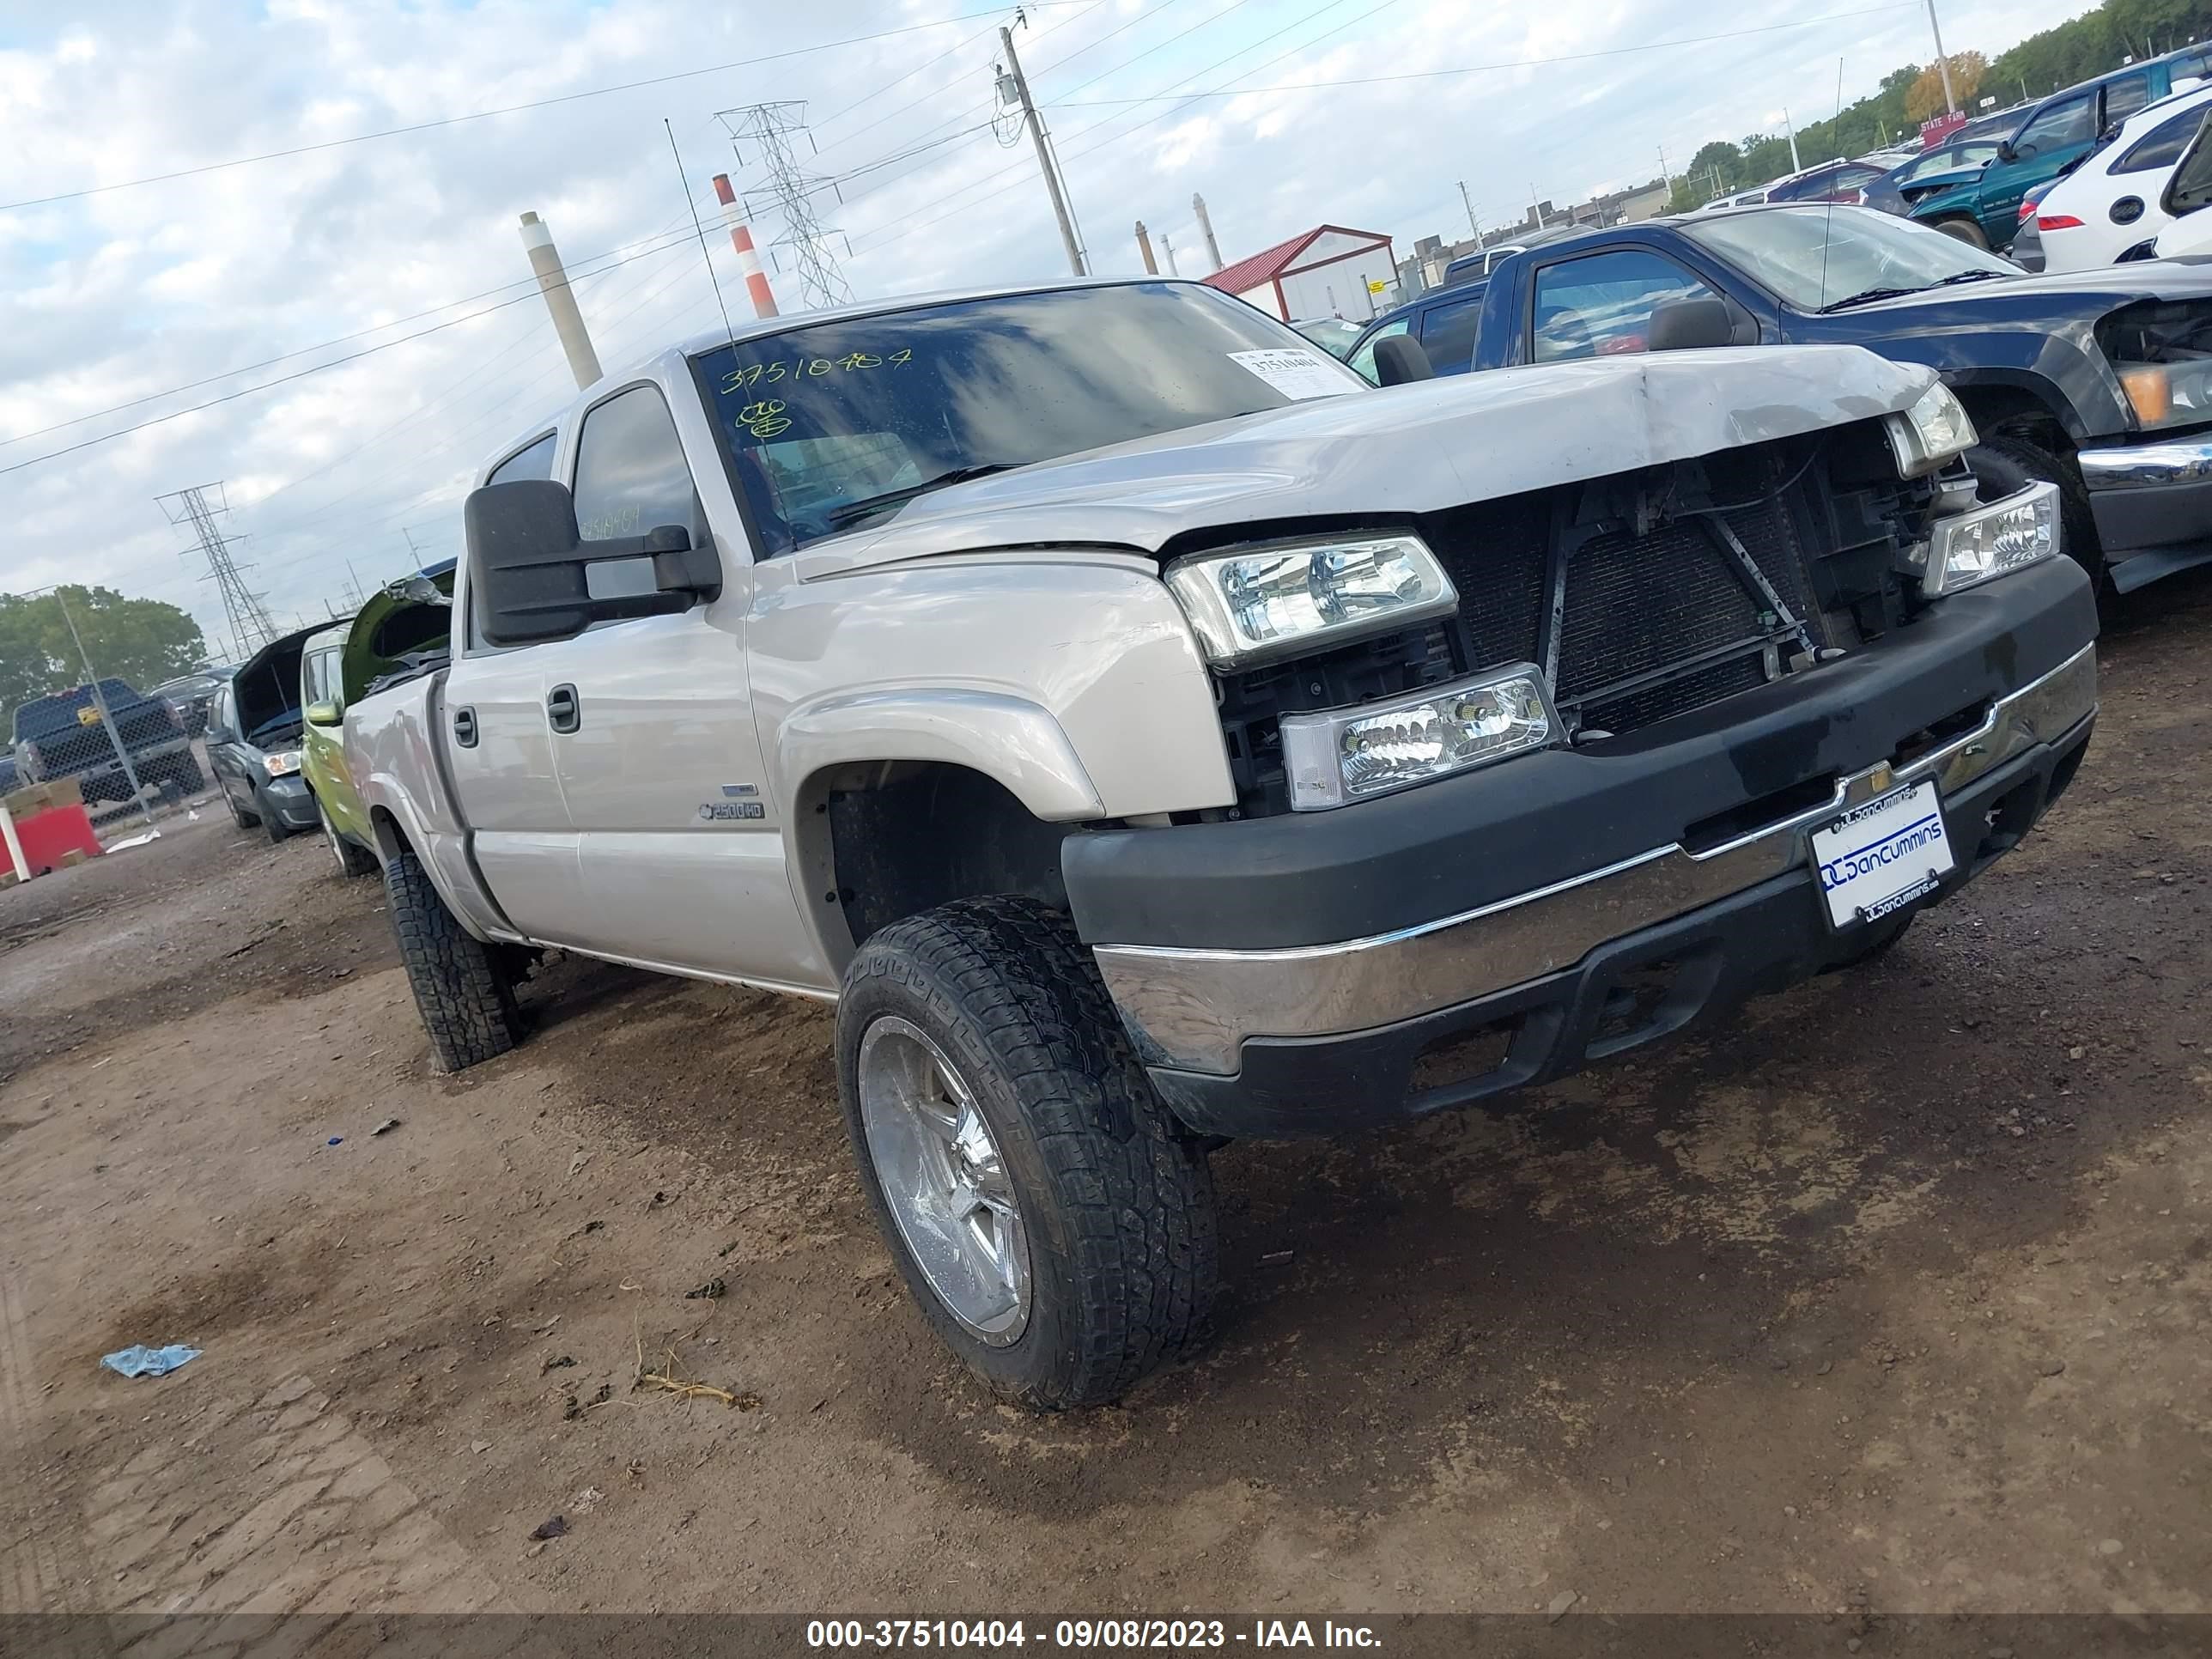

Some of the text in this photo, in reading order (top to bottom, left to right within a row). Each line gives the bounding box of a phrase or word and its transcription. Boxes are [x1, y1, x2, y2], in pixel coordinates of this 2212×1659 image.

[1920, 110, 1966, 132] STATE FARM
[720, 349, 912, 395] 37510404
[1252, 357, 1321, 372] 37510404
